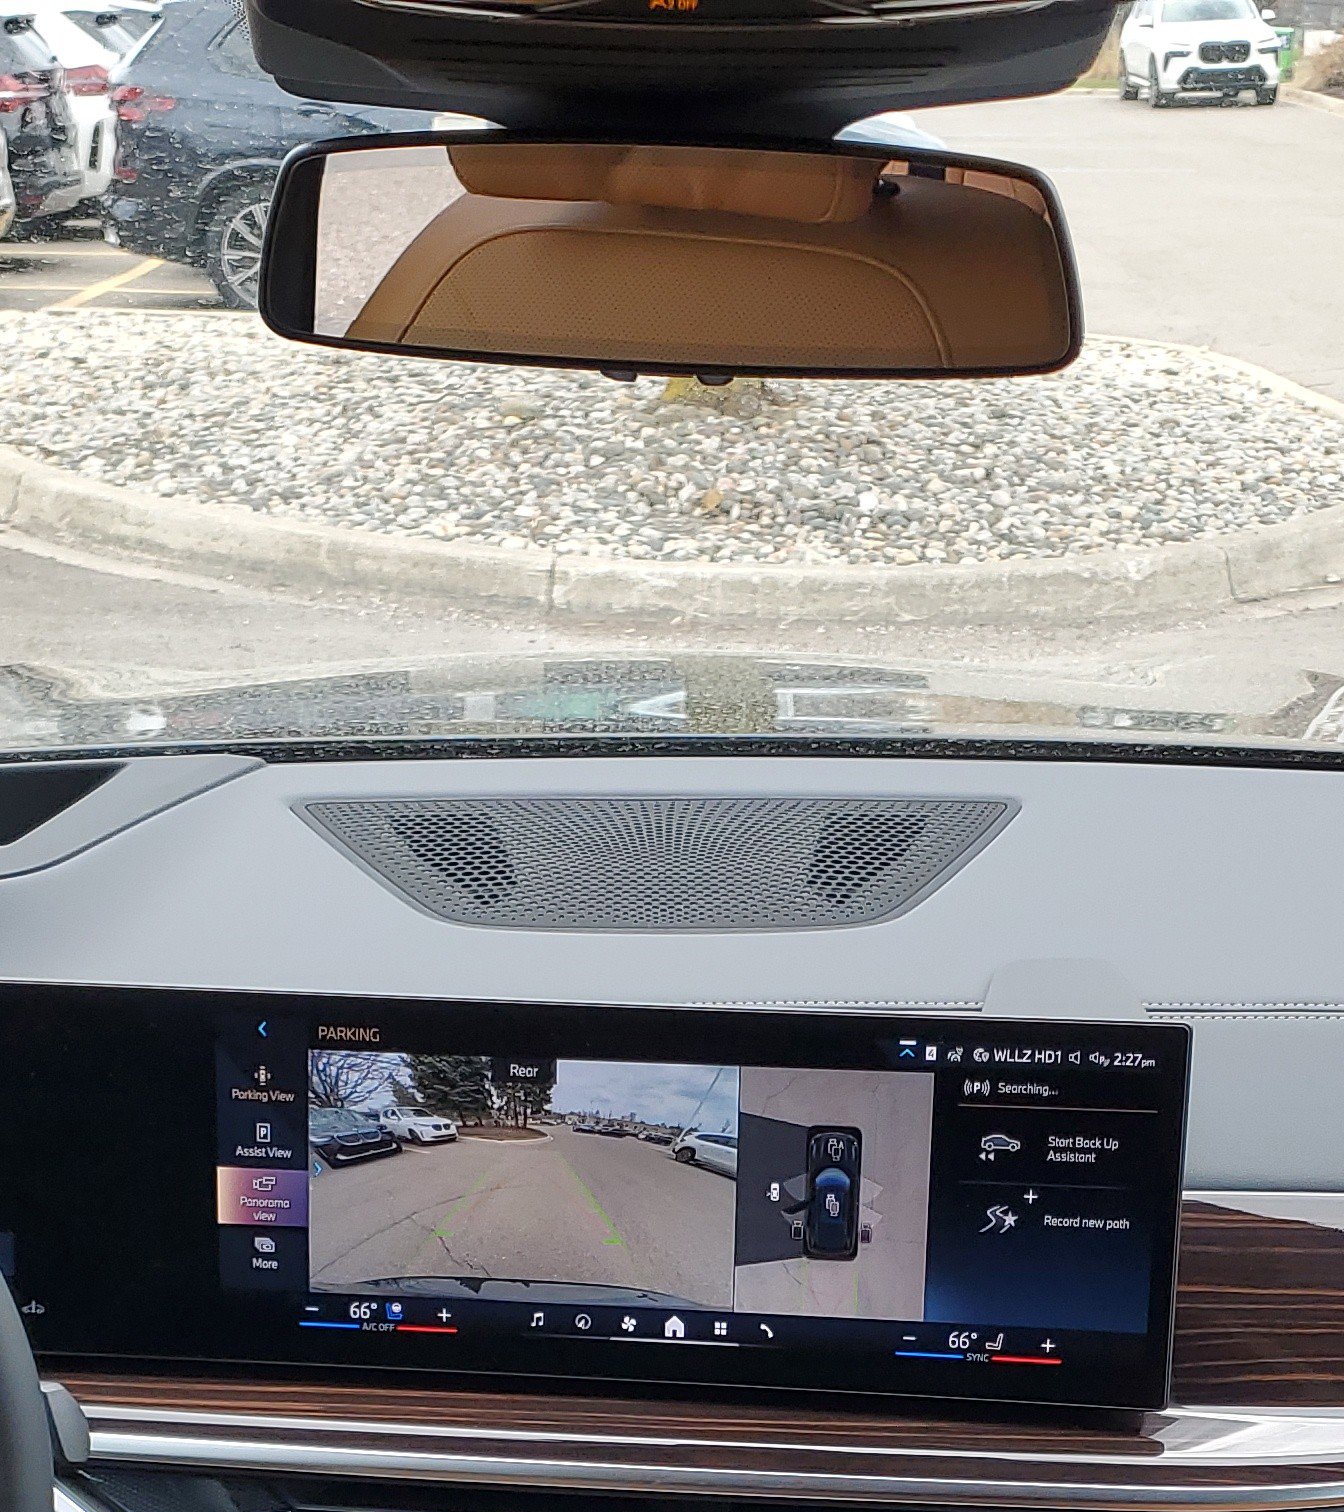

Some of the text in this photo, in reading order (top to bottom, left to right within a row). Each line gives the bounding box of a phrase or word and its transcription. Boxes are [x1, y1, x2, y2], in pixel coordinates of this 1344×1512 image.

[318, 1026, 380, 1042] PARKING
[994, 1048, 1062, 1064] WLLZ HD1
[510, 1064, 539, 1077] Rear
[231, 1088, 295, 1103] Parking View
[1047, 1136, 1119, 1151] Start Back Up
[235, 1146, 292, 1159] Assist View
[1046, 1149, 1096, 1163] Assistant
[240, 1196, 291, 1209] Panorama
[252, 1211, 277, 1222] view
[1044, 1215, 1130, 1230] Record new path
[252, 1258, 278, 1269] More
[362, 1322, 395, 1333] A/C OFF
[966, 1353, 990, 1363] SYNC
